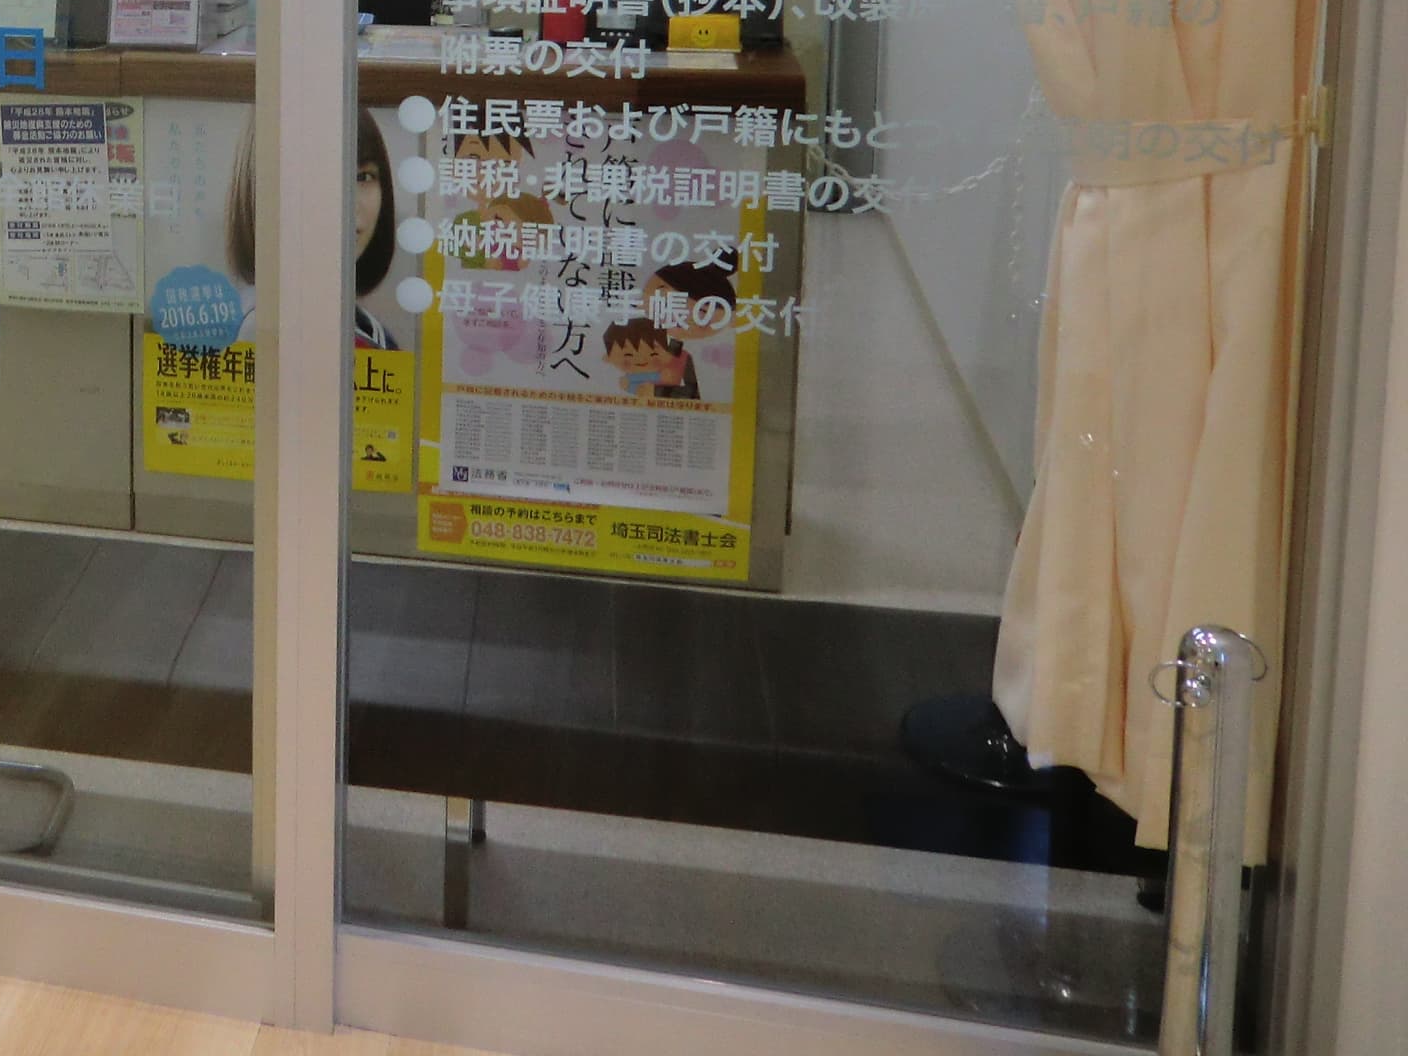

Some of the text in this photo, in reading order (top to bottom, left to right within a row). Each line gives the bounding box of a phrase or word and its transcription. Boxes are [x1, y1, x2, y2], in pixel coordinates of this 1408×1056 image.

[439, 37, 652, 80] 附票の交付
[435, 220, 780, 273] 納税証明書の交付
[159, 301, 229, 329] 2016.6.19
[353, 356, 403, 393] 上に。
[471, 520, 597, 548] 048-838-7472
[610, 521, 738, 549] 埼玉司法書士会
